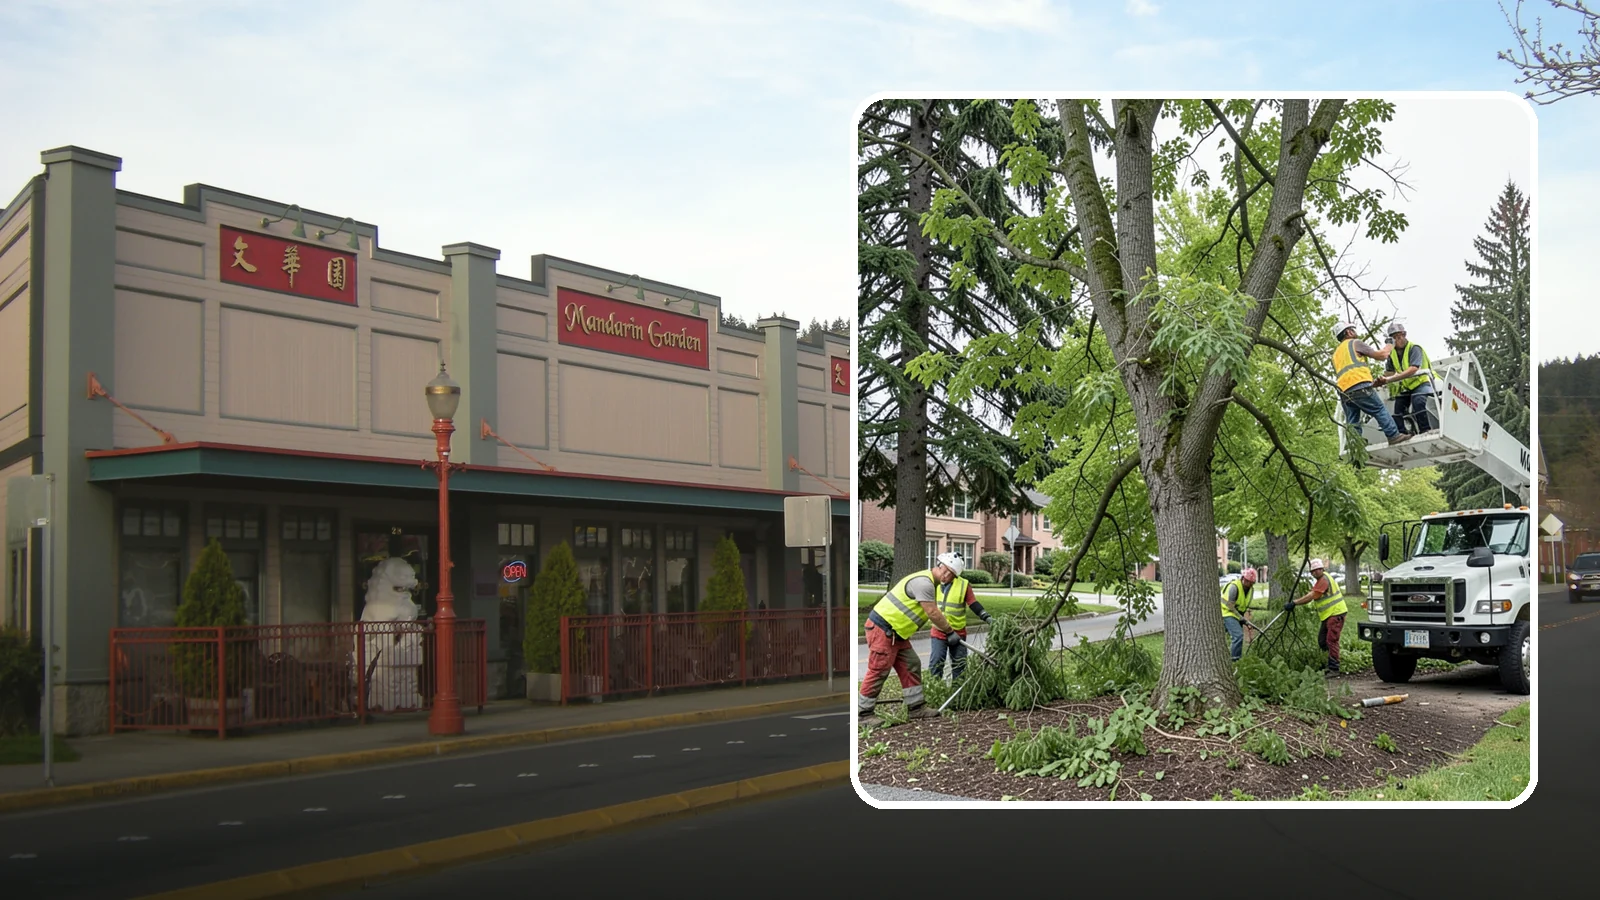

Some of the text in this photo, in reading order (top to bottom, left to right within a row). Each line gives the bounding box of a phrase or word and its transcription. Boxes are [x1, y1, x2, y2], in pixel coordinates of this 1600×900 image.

[231, 235, 346, 291] 文華園
[564, 302, 701, 352] Mandarin Garden
[503, 565, 527, 578] OPEN
